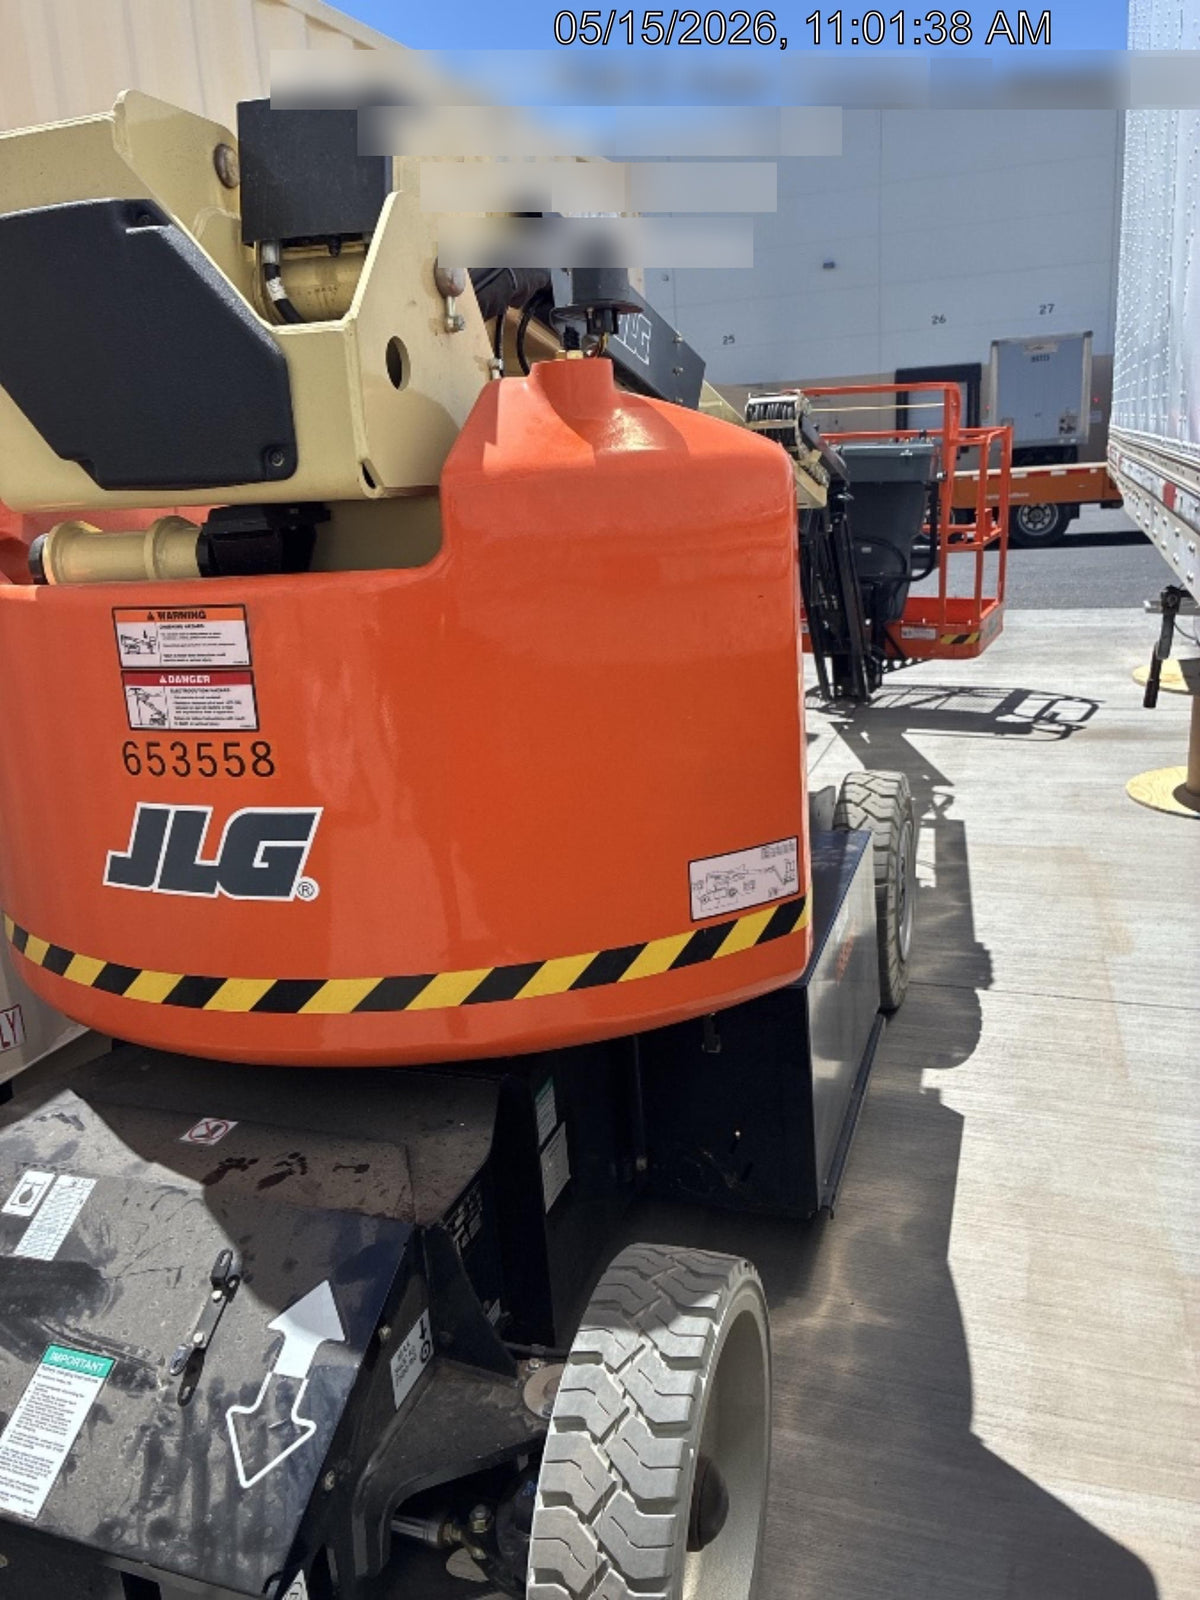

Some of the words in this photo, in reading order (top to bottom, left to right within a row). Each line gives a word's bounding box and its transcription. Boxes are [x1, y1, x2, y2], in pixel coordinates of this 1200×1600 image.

[1038, 303, 1056, 315] 27
[931, 314, 947, 325] 26
[722, 335, 736, 345] 25
[157, 611, 207, 621] WARNING
[168, 675, 210, 684] DANGER
[121, 740, 276, 778] 653558
[49, 1351, 105, 1374] IMPORTANT
